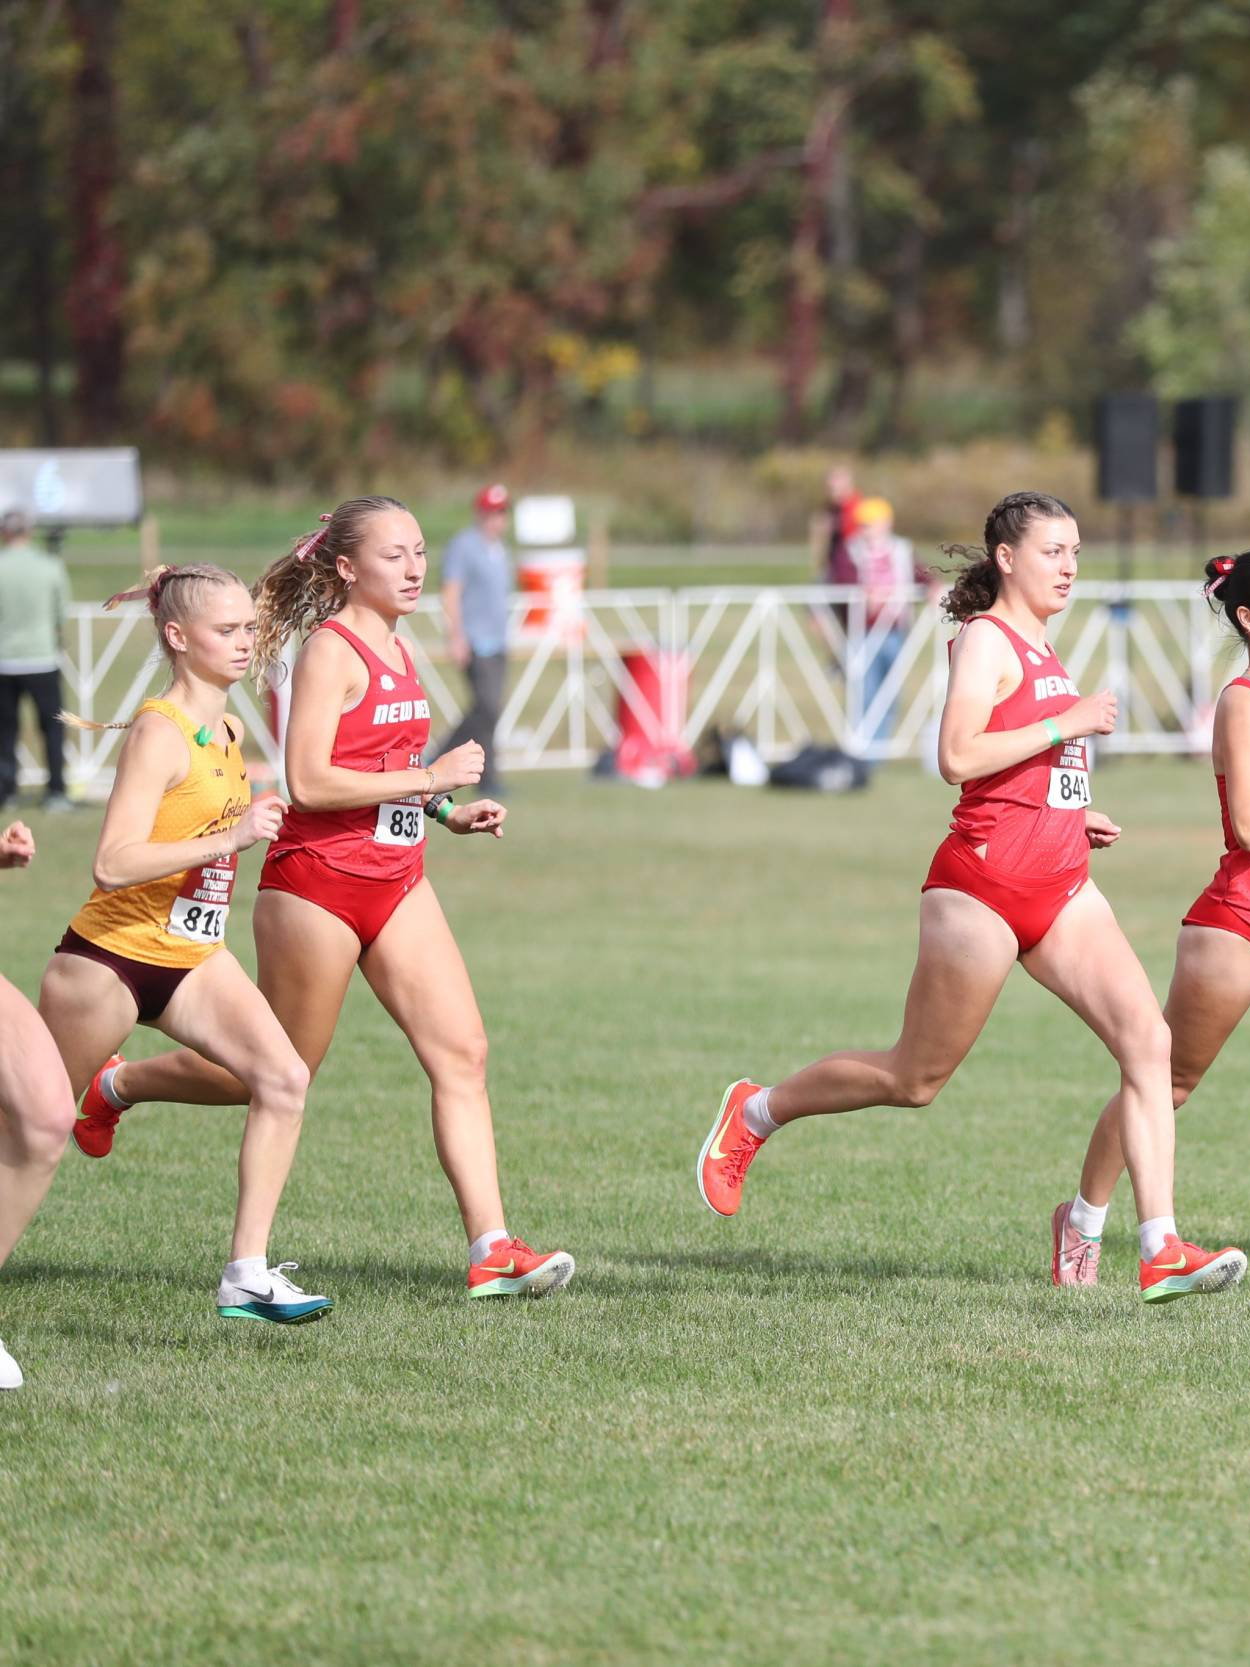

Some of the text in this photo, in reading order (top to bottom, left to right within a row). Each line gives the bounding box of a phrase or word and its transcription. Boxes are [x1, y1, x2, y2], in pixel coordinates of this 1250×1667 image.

[373, 701, 412, 725] NEW
[1060, 773, 1088, 802] 841
[390, 809, 419, 839] 835
